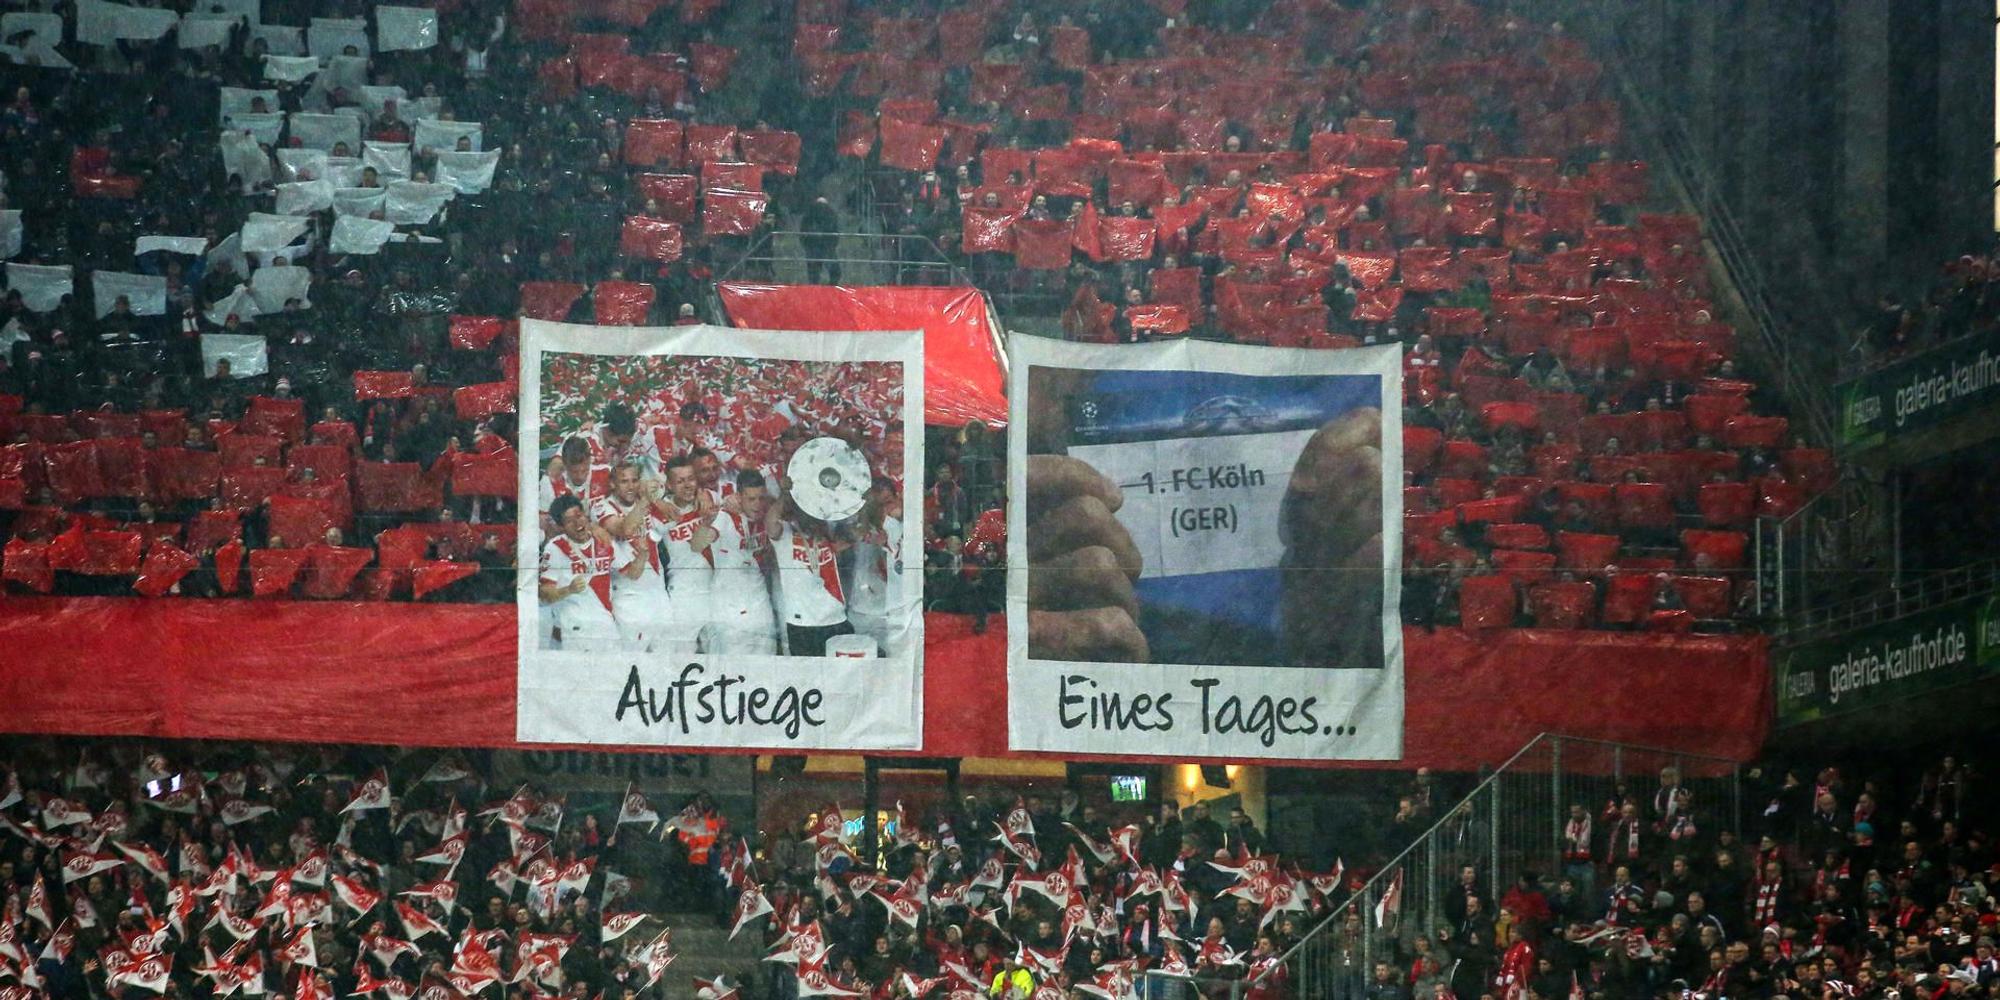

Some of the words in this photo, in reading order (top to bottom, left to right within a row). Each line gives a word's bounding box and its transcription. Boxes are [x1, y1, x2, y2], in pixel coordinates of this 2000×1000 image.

[1142, 471, 1166, 494] 1.
[1172, 466, 1203, 492] FC
[1208, 463, 1265, 489] Köln
[1171, 503, 1238, 538] (GER)
[615, 662, 826, 739] Aufstiege
[1829, 623, 1966, 704] galeria-kaufhof.de
[1058, 674, 1174, 732] Eines
[1190, 678, 1357, 748] Tages...
